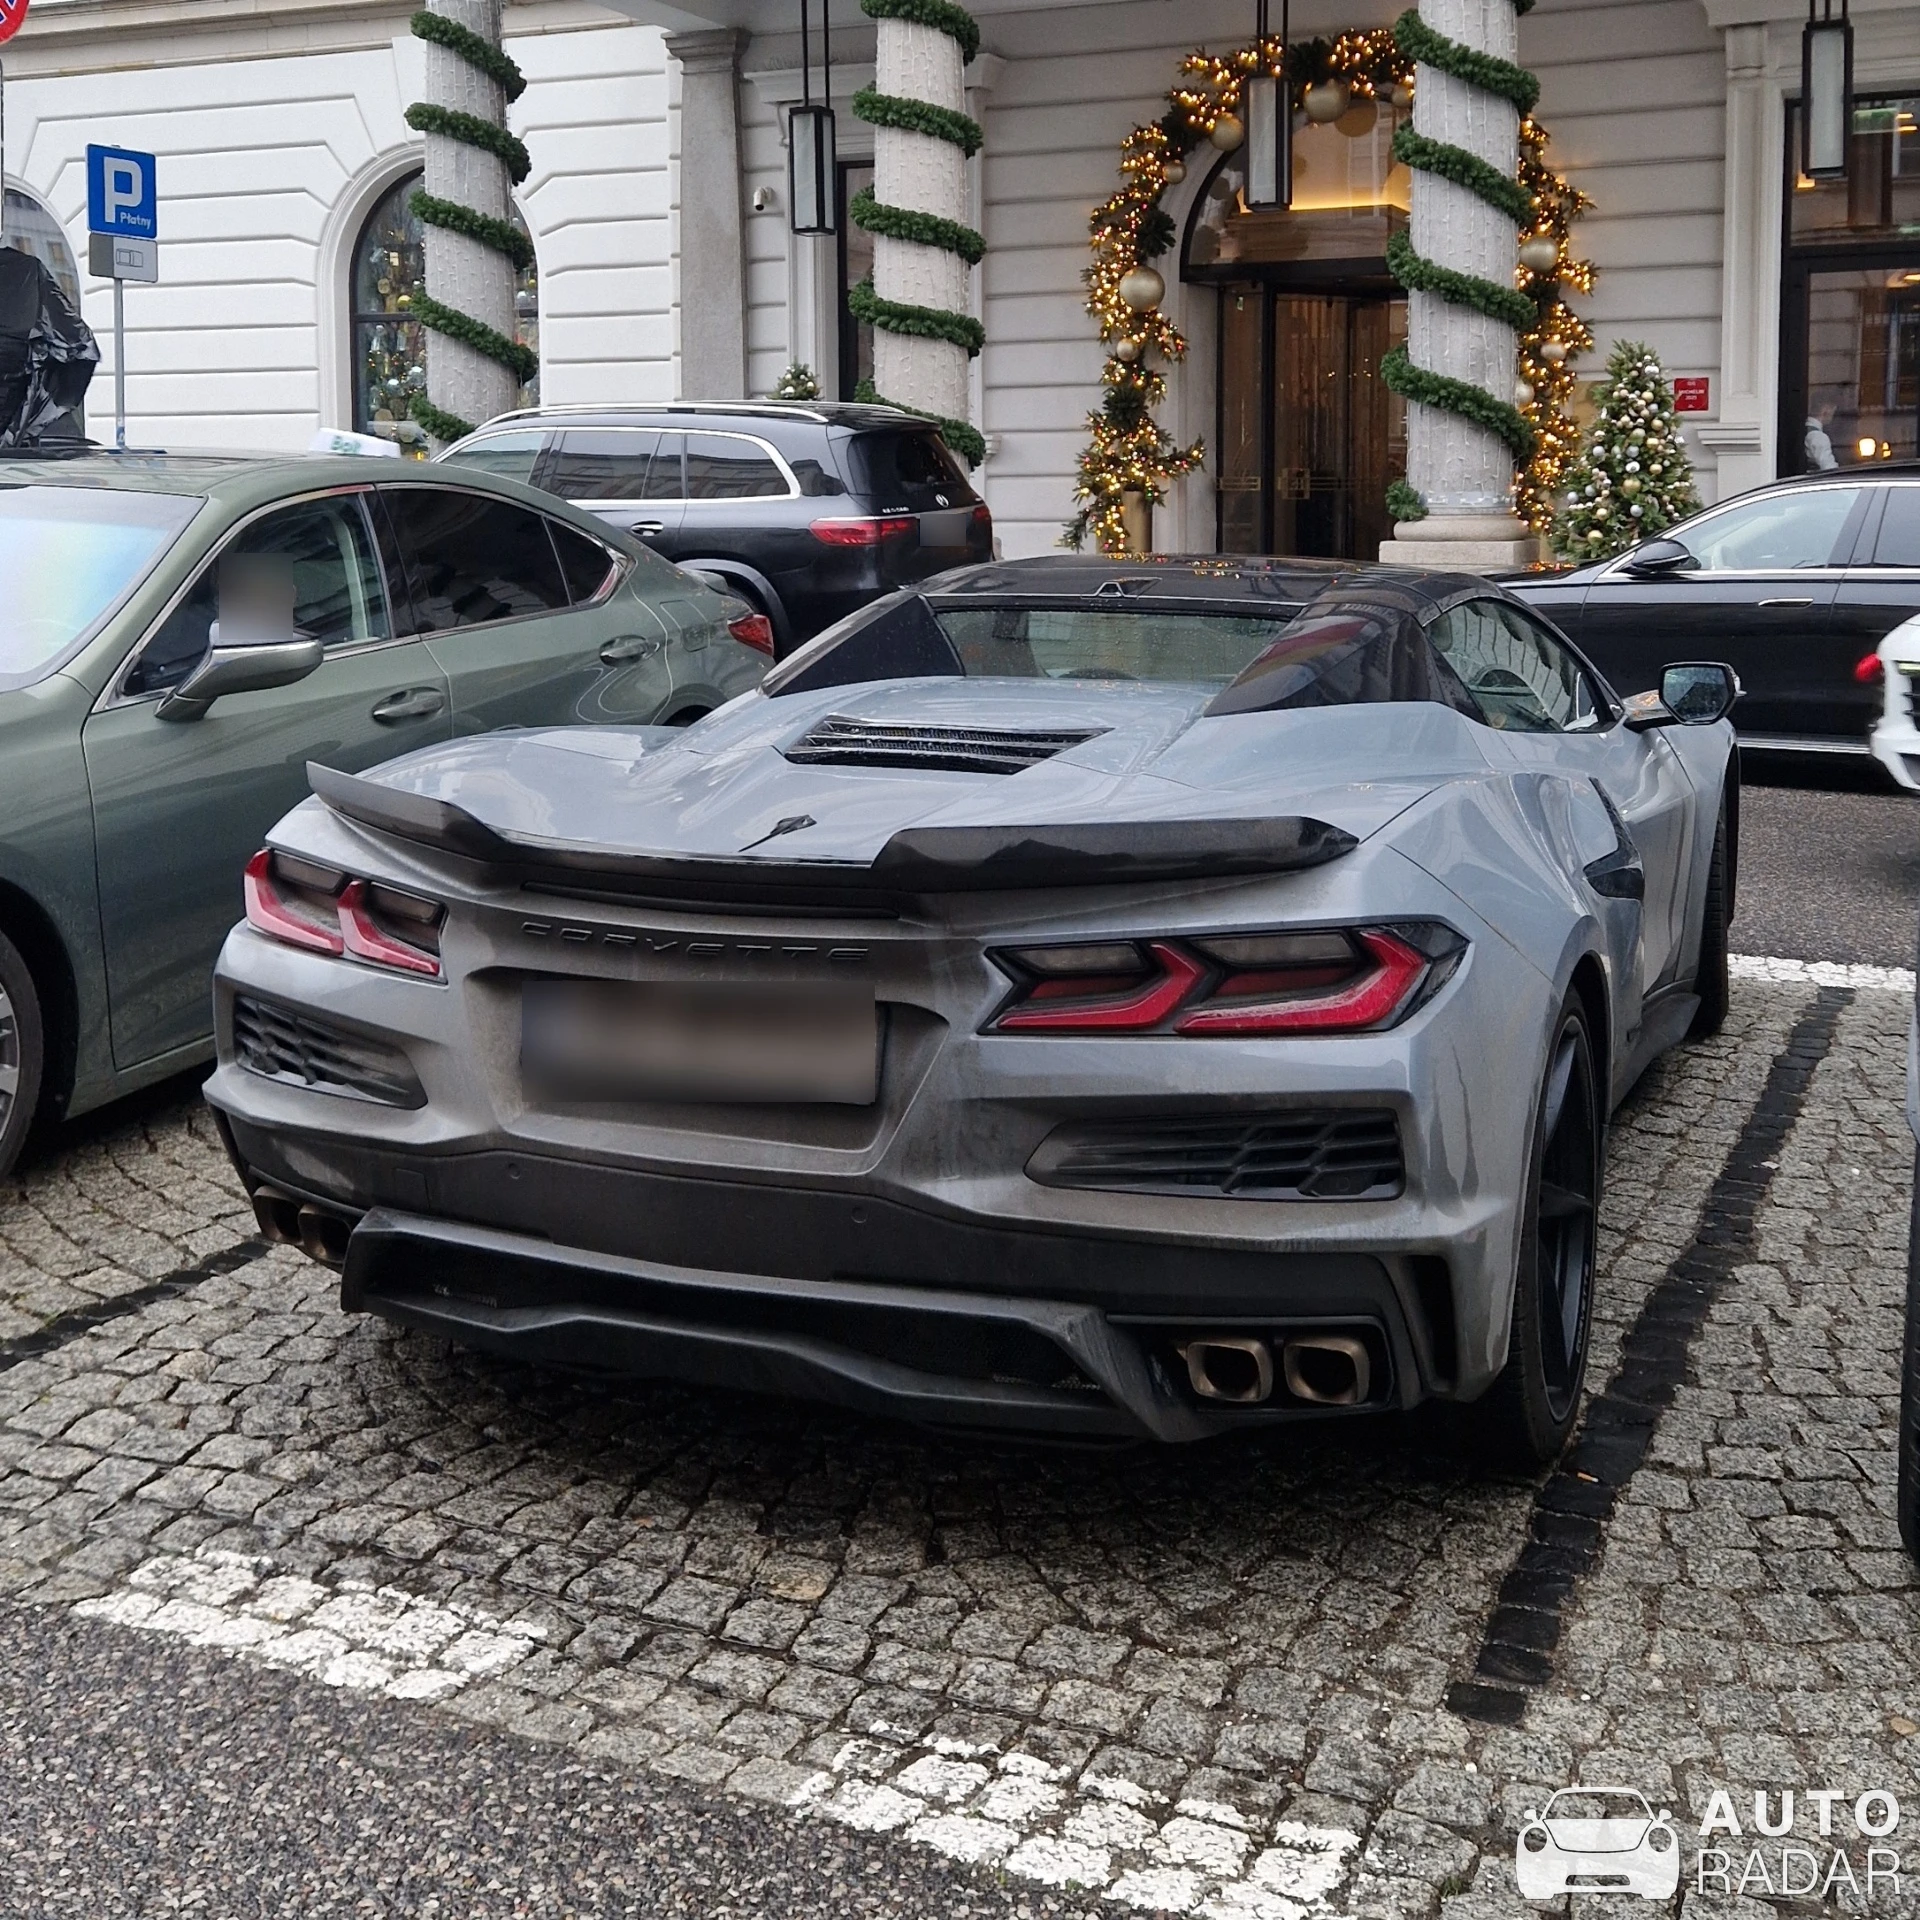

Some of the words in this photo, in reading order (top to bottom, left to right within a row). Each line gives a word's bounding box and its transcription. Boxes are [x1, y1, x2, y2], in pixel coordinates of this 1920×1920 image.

[103, 156, 143, 223] P
[120, 211, 152, 230] Płatny
[521, 921, 869, 961] CORVETTE
